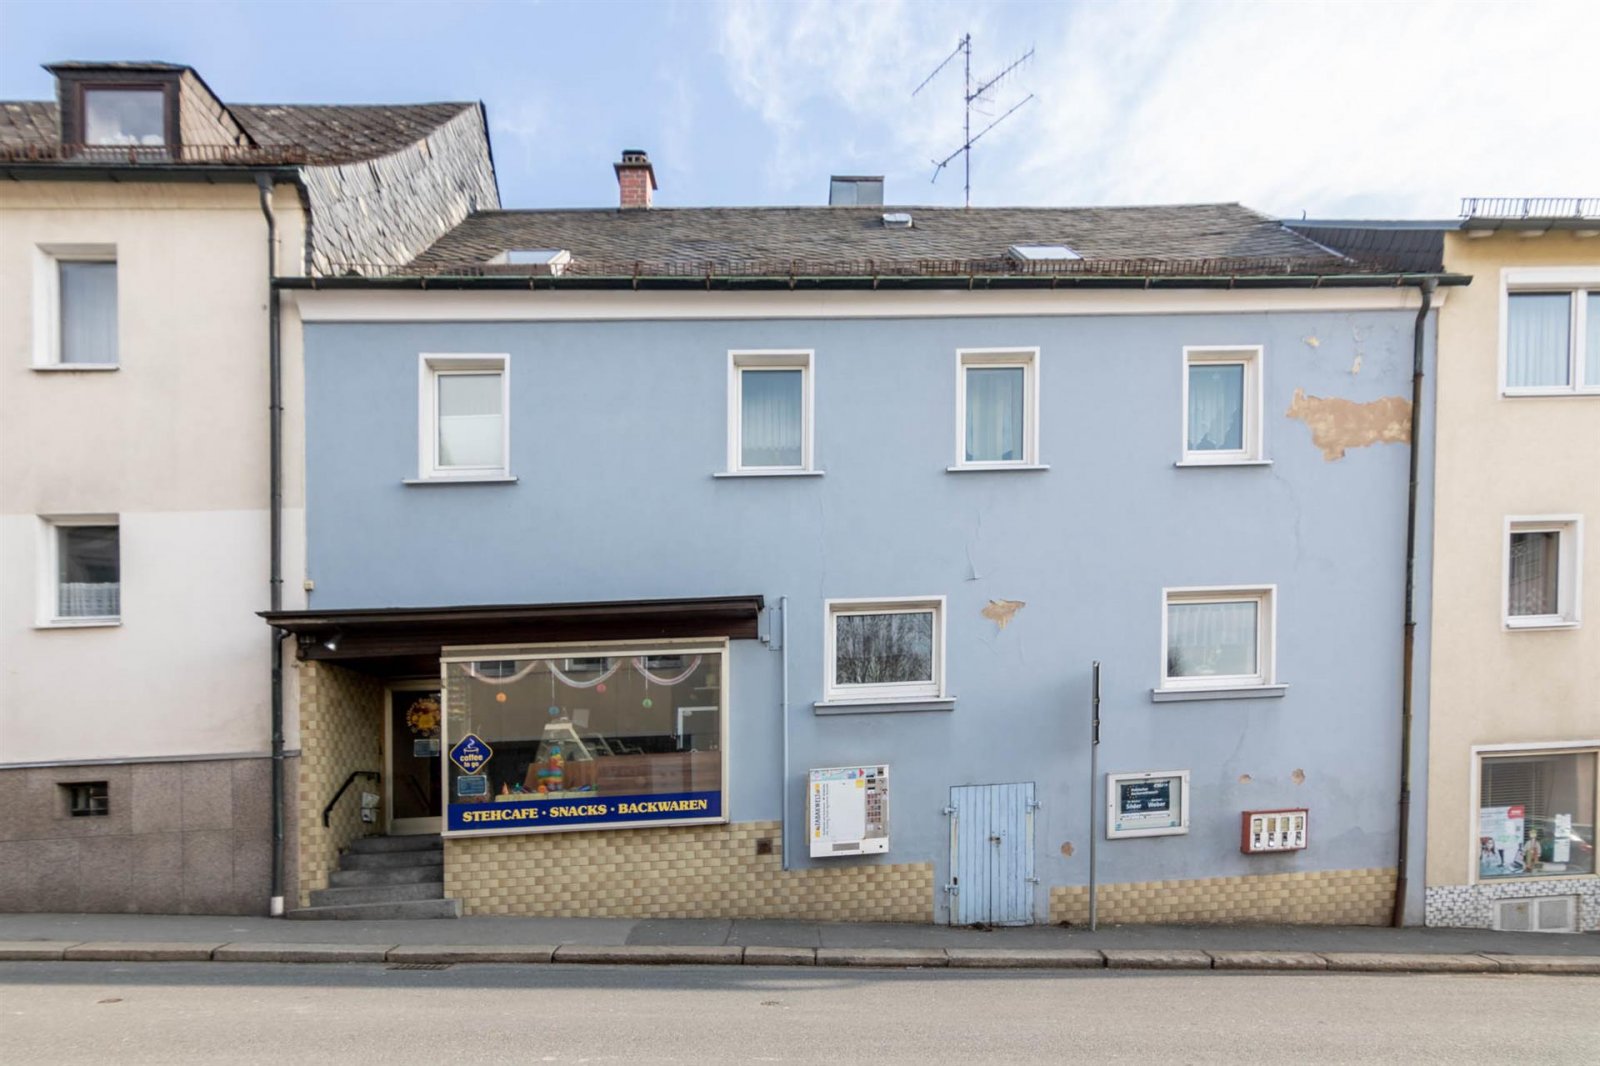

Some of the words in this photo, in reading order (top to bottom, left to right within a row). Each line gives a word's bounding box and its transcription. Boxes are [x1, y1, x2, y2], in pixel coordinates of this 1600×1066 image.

[462, 808, 538, 822] STEHCAFE
[550, 804, 607, 817] SNACKS
[618, 799, 708, 815] BACKWAREN
